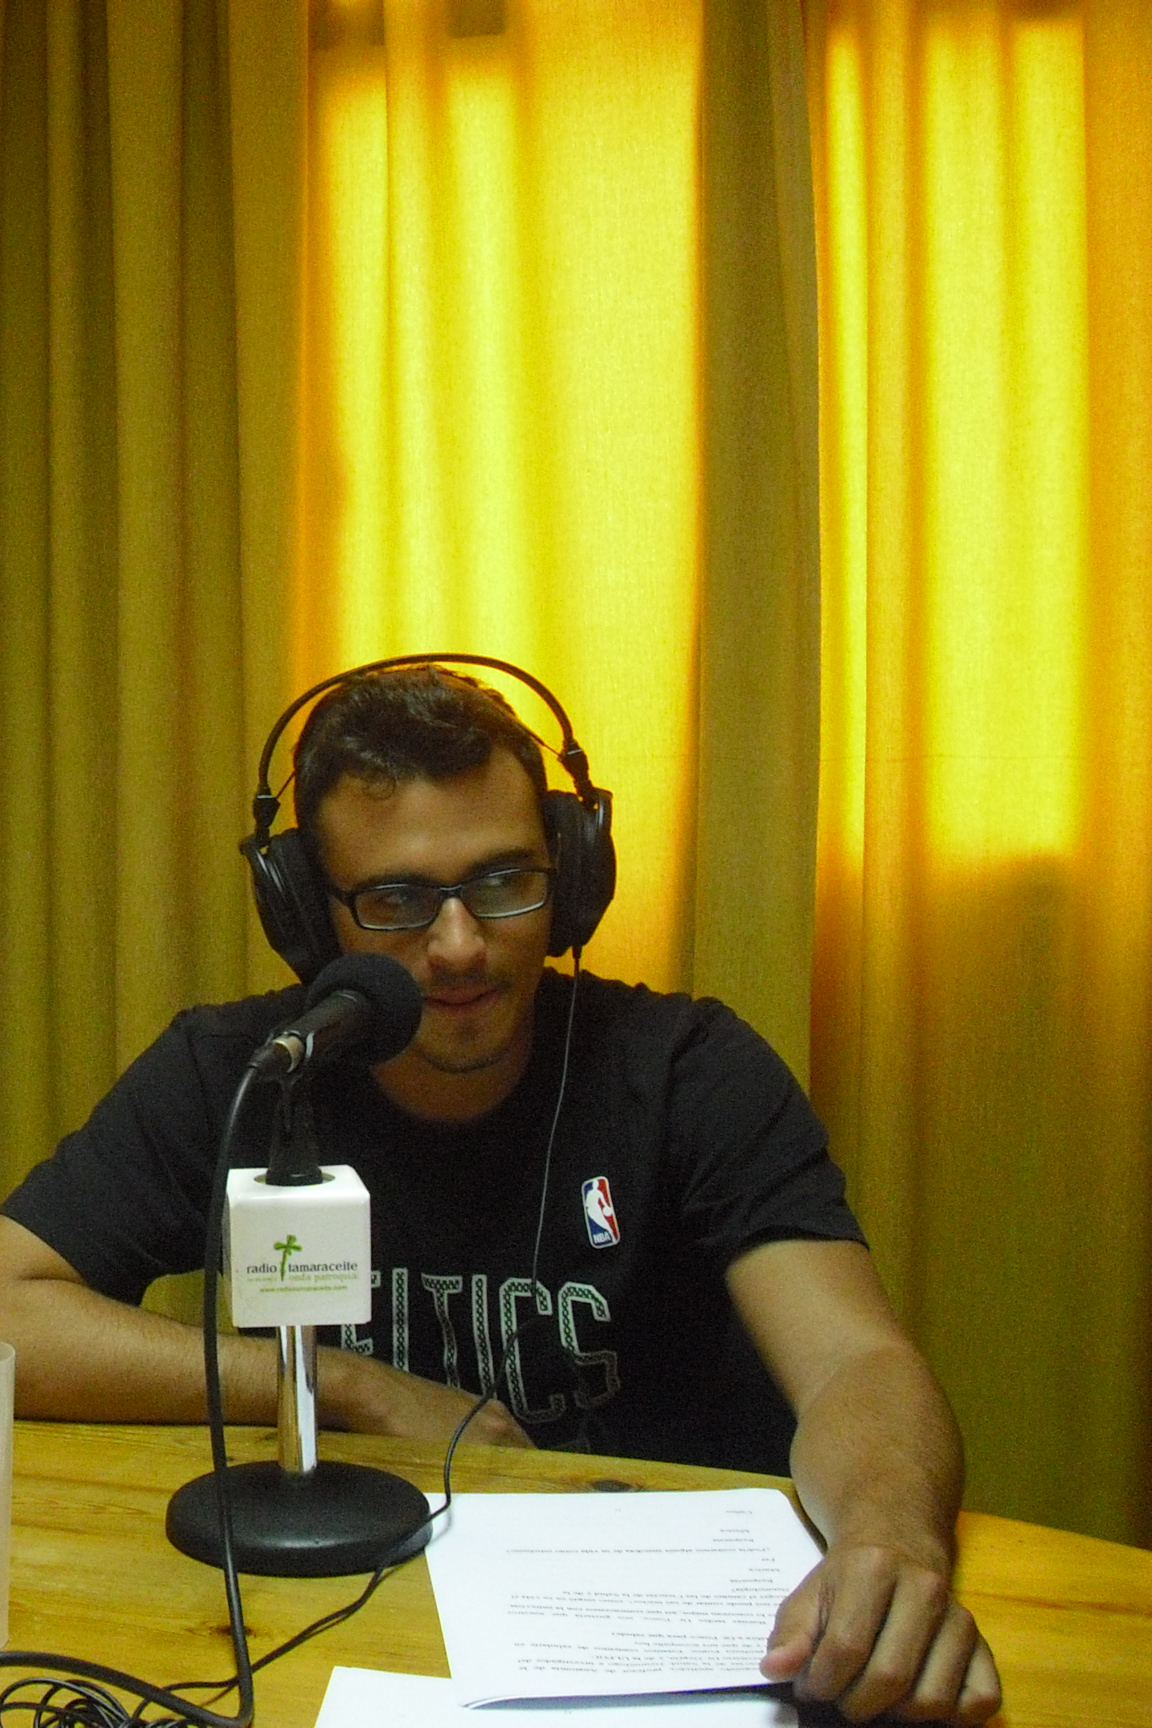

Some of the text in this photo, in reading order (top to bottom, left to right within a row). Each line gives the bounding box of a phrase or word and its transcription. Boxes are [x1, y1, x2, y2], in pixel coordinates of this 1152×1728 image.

[592, 1231, 612, 1245] NBA
[247, 1261, 359, 1274] radio tamaraceite
